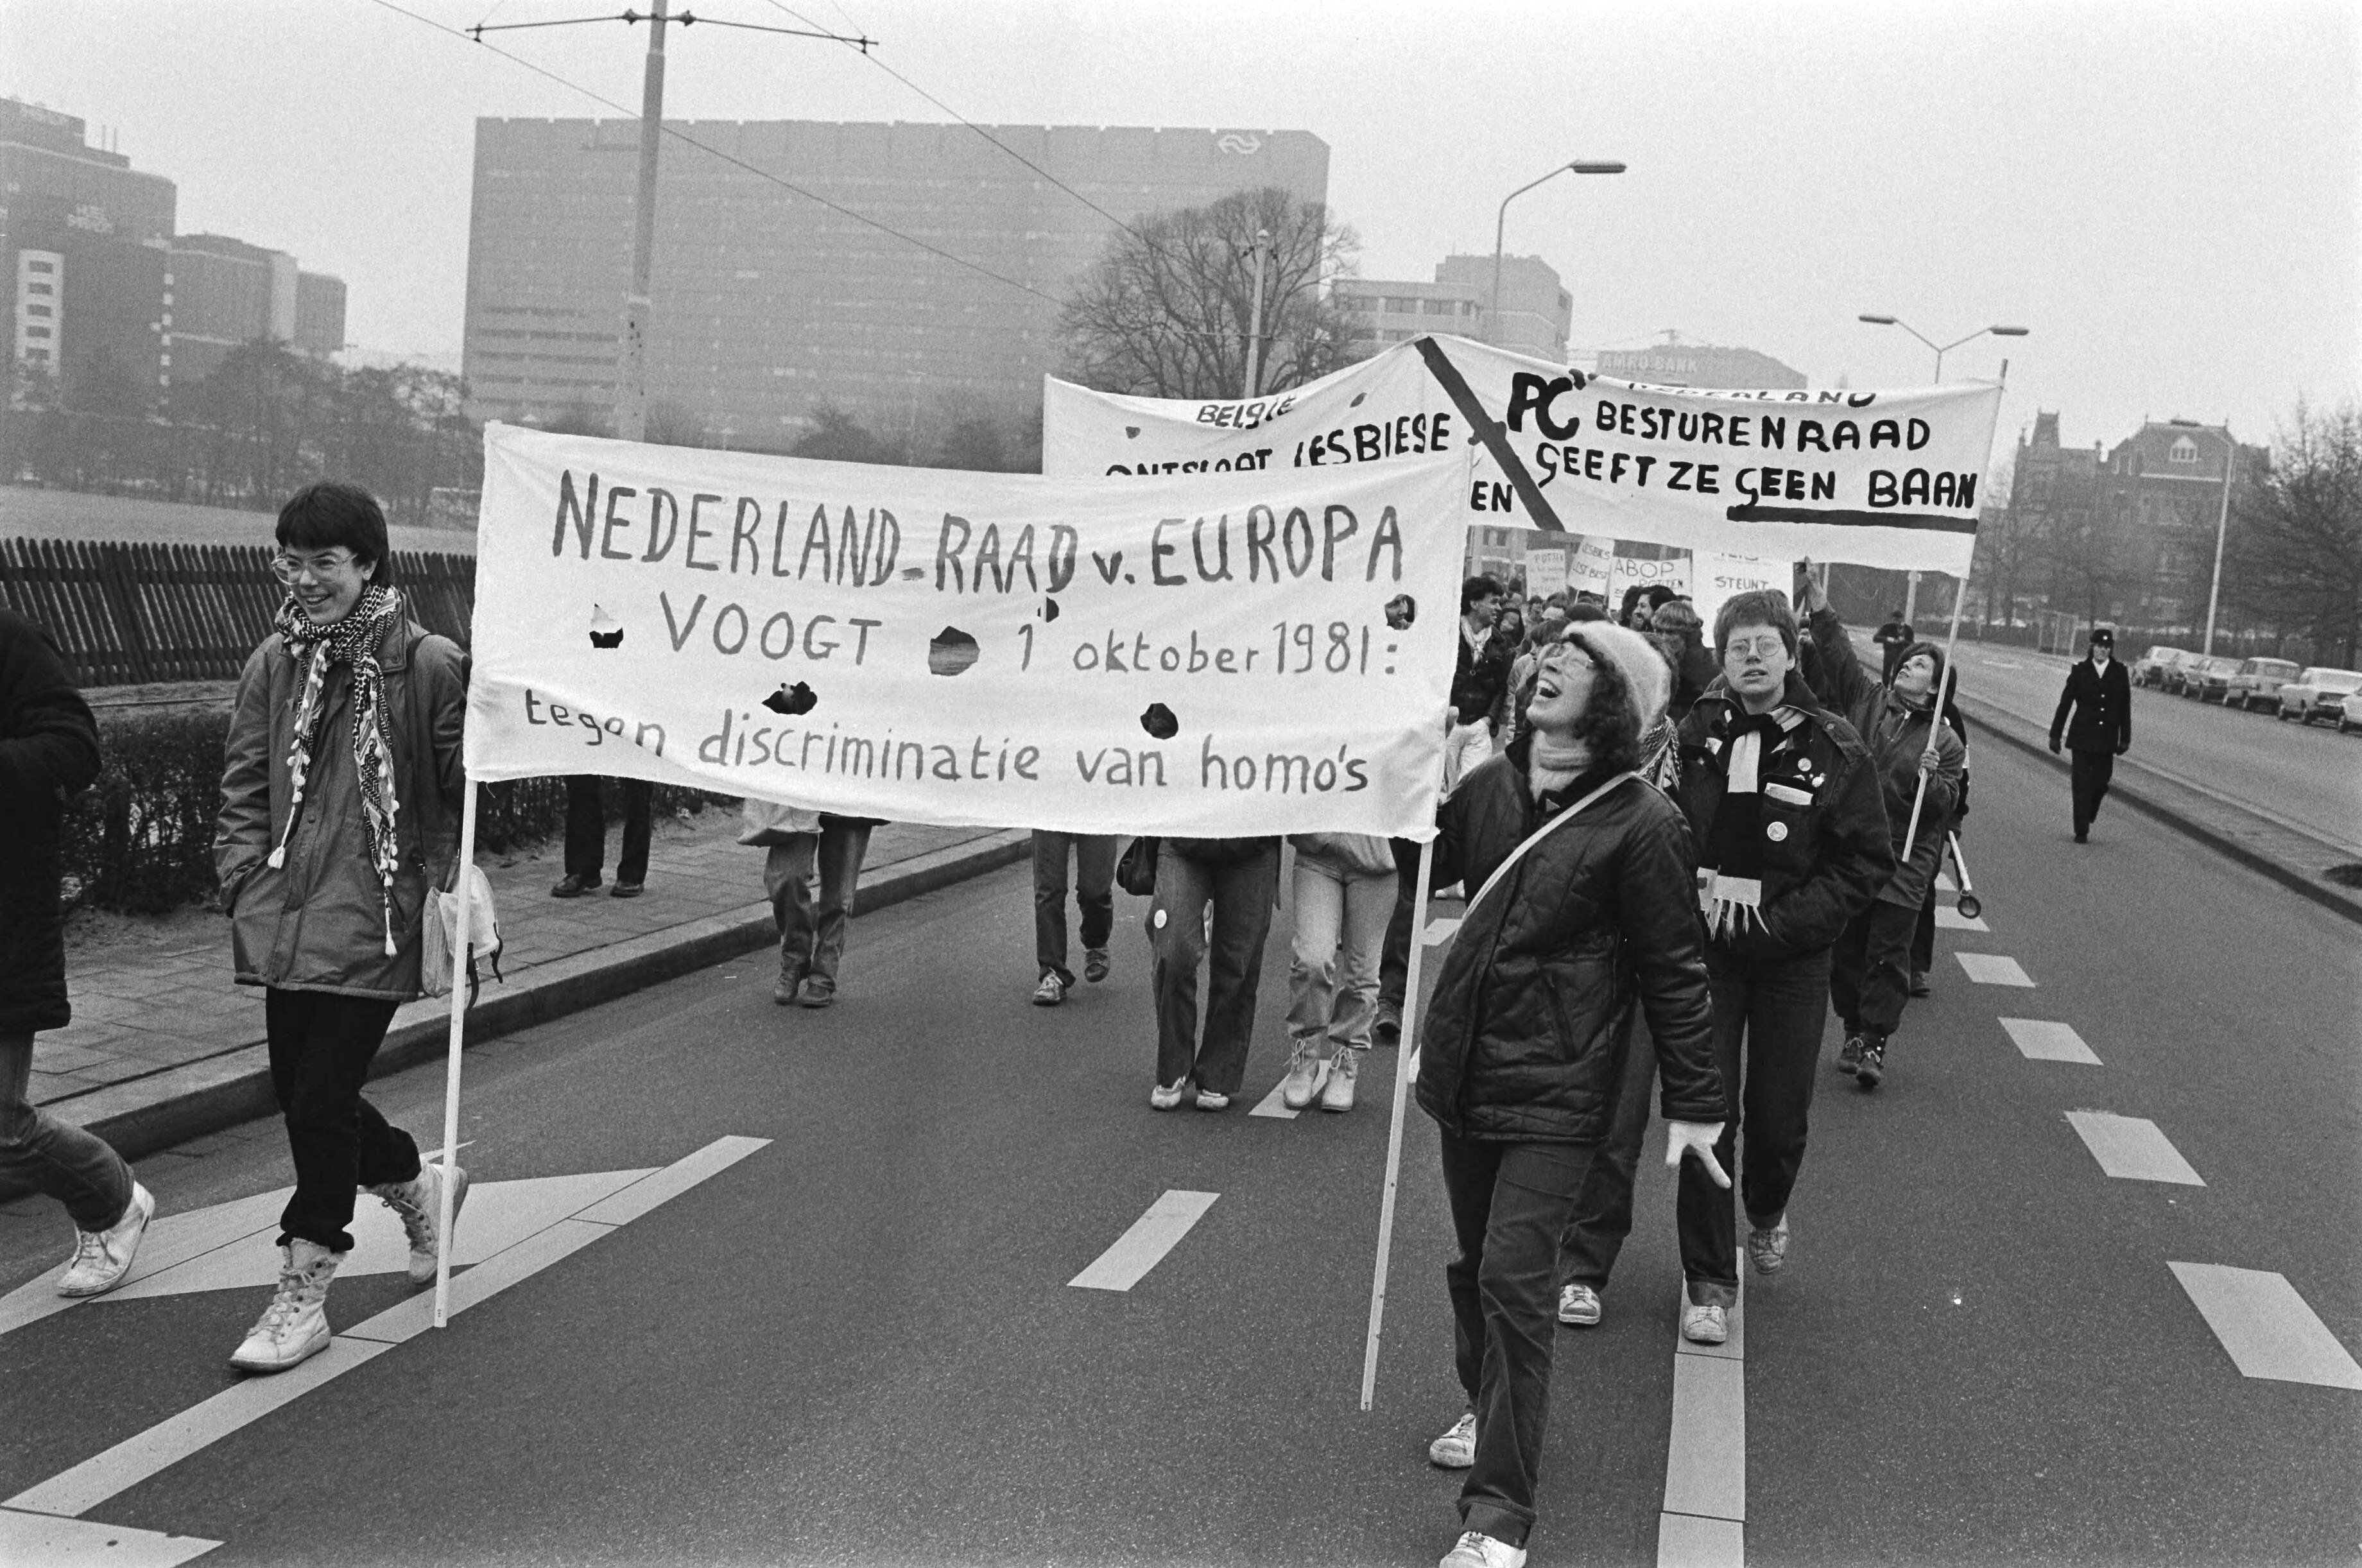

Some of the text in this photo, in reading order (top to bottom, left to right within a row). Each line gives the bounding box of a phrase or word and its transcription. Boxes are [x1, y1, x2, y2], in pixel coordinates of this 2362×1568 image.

[1470, 480, 1513, 513] EN
[1536, 442, 1978, 508] GEEFT ZE GEEN BAAN
[1092, 551, 1136, 585] v.
[1150, 504, 1404, 587] EUROPA
[1614, 558, 1675, 578] ABOP
[1714, 575, 1770, 590] STEUNT
[660, 591, 883, 665] VOOGT
[1017, 623, 1034, 672] 1
[1073, 628, 1259, 674] oktober
[698, 708, 1040, 782] discriminatie
[1076, 748, 1168, 787] van
[1202, 734, 1368, 795] homo's
